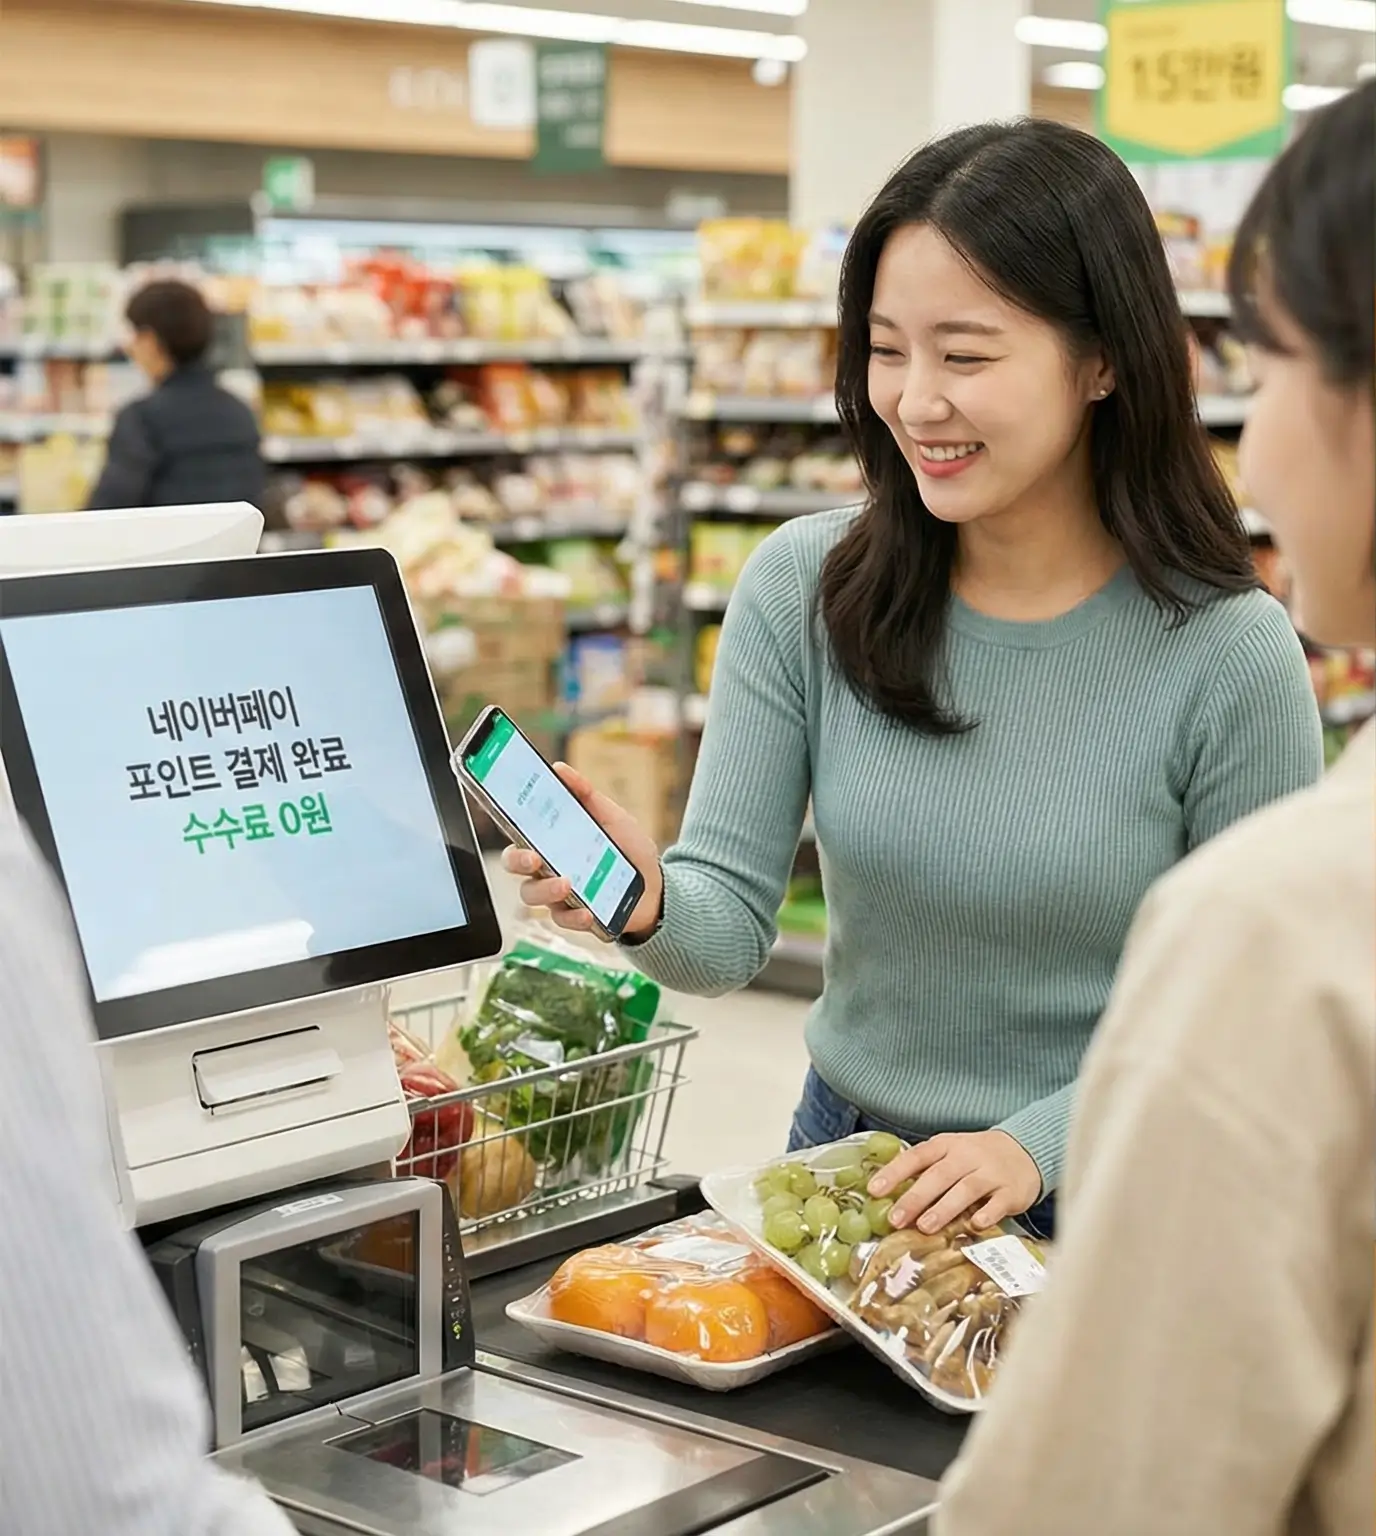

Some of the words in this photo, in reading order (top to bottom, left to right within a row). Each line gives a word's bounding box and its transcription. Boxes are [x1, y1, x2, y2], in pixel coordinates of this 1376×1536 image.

[146, 685, 300, 741] 네이버페이
[126, 754, 222, 800] 포인트
[224, 742, 288, 790] 결제
[290, 736, 352, 780] 완료
[183, 803, 275, 854] 수수료
[278, 792, 333, 835] 0원
